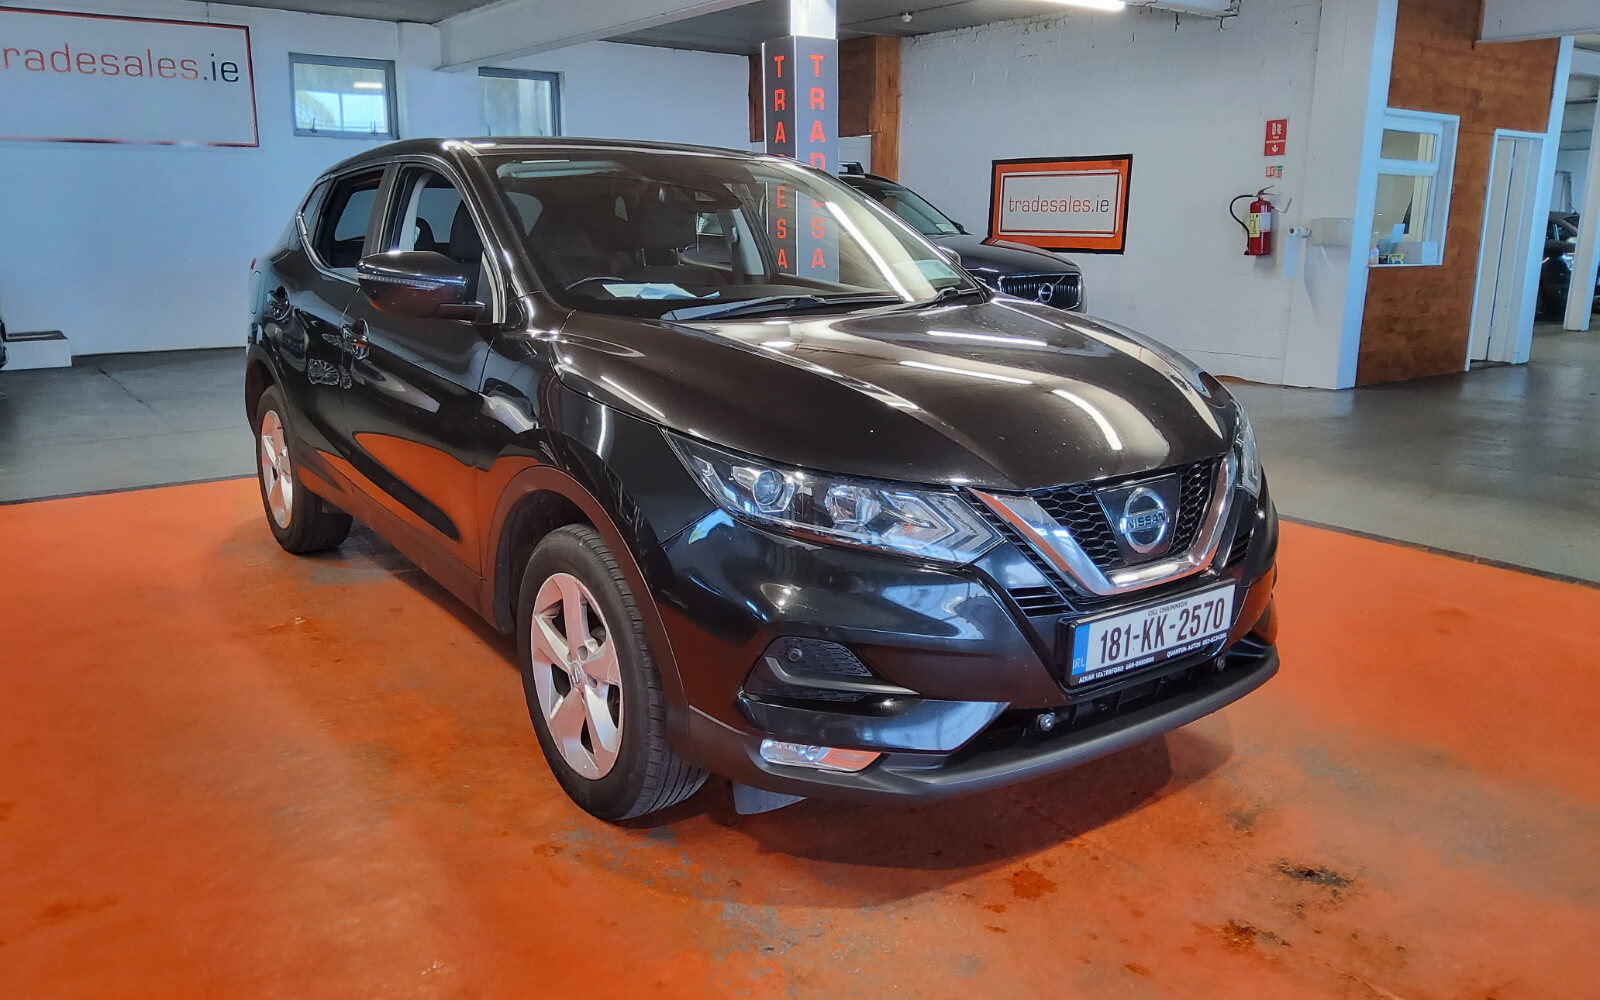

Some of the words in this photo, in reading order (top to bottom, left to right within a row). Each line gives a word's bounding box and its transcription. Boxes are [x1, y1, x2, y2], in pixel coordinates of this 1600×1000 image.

[2, 43, 240, 83] radesales.ie
[1008, 194, 1110, 213] tradesales.ie
[1126, 512, 1166, 529] NISSAN
[1100, 597, 1225, 664] 181-KK-2570
[1072, 656, 1086, 670] IRL
